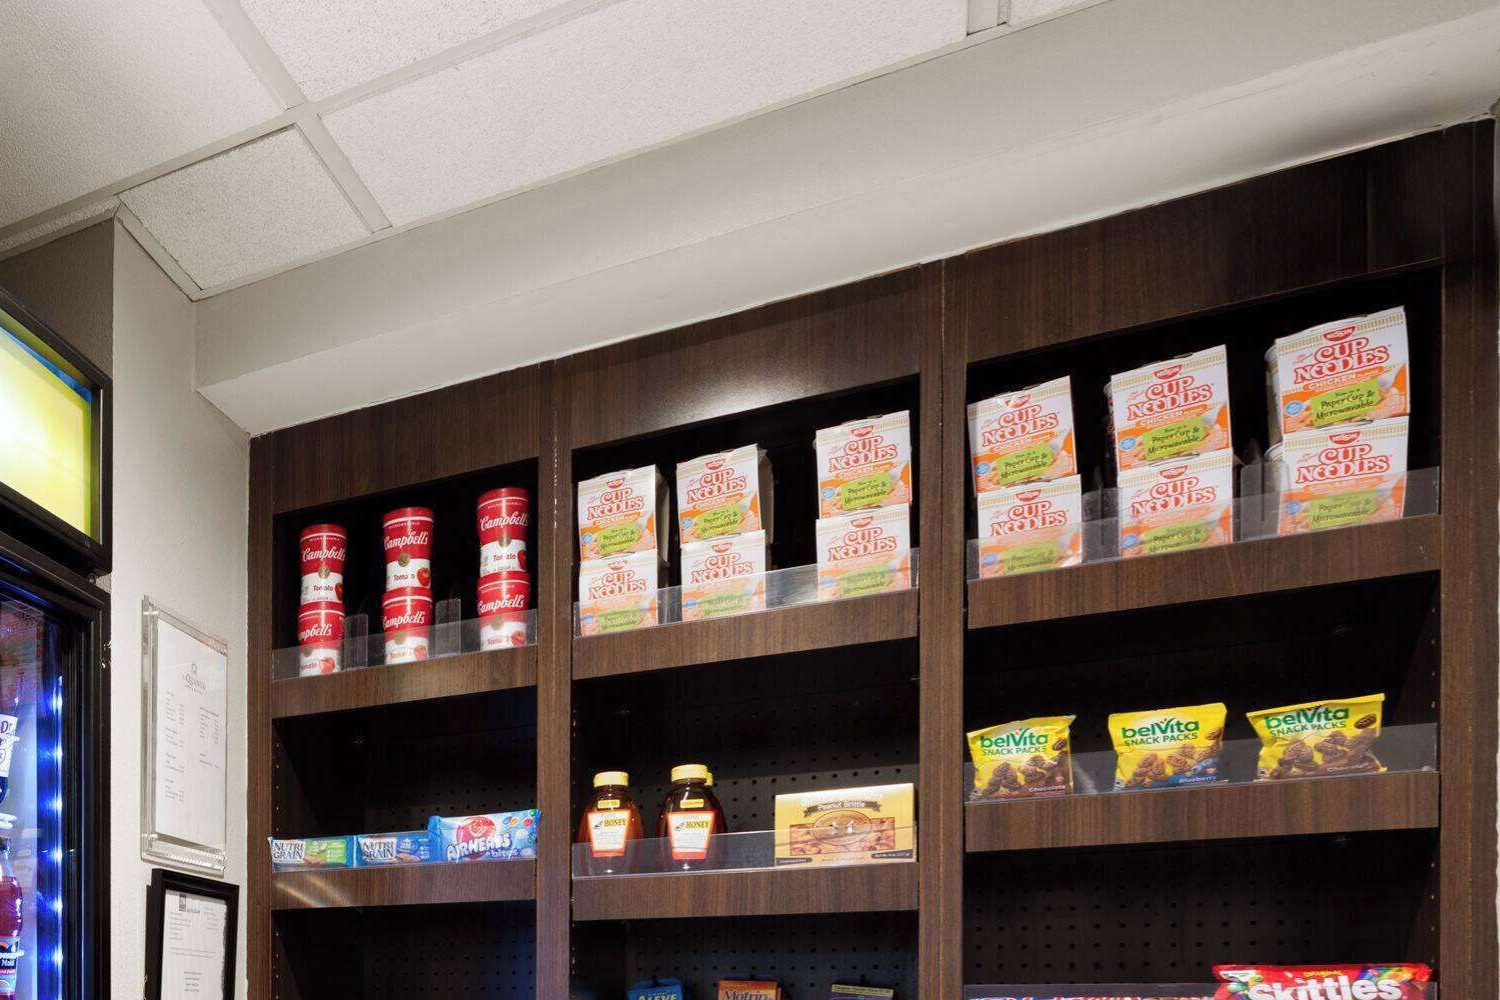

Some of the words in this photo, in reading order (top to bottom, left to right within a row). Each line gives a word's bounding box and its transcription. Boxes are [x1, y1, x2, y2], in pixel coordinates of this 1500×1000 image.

[1314, 337, 1369, 363] CUP
[1293, 346, 1390, 384] NOODLES
[1146, 375, 1194, 399] CUP
[1127, 384, 1213, 421] NOODLES
[1320, 397, 1346, 408] Paper
[1347, 393, 1365, 403] Cup
[999, 405, 1041, 427] CUP
[1316, 400, 1374, 421] Microwavable
[982, 413, 1059, 447] NOODLES
[1151, 434, 1174, 444] Paper
[1175, 430, 1190, 438] Cup
[844, 436, 883, 455] CUP
[1148, 436, 1200, 455] Microwavable
[1319, 444, 1372, 465] CUP
[828, 444, 898, 472] NOODLES
[1004, 459, 1025, 469] Paper
[700, 468, 735, 486] CUP
[1296, 455, 1390, 484] NOODLES
[601, 488, 632, 504] CUP
[686, 476, 747, 504] NOODLES
[1150, 477, 1199, 500] CUP
[587, 496, 644, 520] NOODLES
[1008, 501, 1050, 520] CUP
[1131, 487, 1216, 518] NOODLES
[991, 510, 1068, 537] NOODLES
[384, 531, 429, 550] Campbell's
[844, 527, 883, 545] CUP
[302, 546, 346, 562] Campbell's
[828, 536, 897, 562] NOODLES
[705, 553, 740, 568] CUP
[602, 570, 635, 585] CUP
[589, 579, 646, 600] NOODLES
[1264, 706, 1349, 728] belVita
[1122, 717, 1199, 739] belVita
[1270, 725, 1308, 738] SNACK
[1310, 721, 1346, 733] PACKS
[980, 729, 1048, 749] belVita
[1124, 735, 1161, 747] SNACK
[1164, 732, 1198, 743] PACKS
[982, 746, 1013, 757] SNACK
[1015, 744, 1047, 755] PACKS
[1326, 762, 1374, 774] Chocolate
[1028, 784, 1067, 793] Chocolate
[1178, 774, 1217, 784] Blueberry
[603, 818, 627, 828] HONEY
[685, 819, 709, 829] HONEY
[273, 851, 302, 860] GRAIN
[274, 841, 303, 852] NUTRI
[362, 850, 396, 860] GRAIN
[363, 841, 396, 852] NUTRI
[446, 833, 513, 862] AIRHEADS
